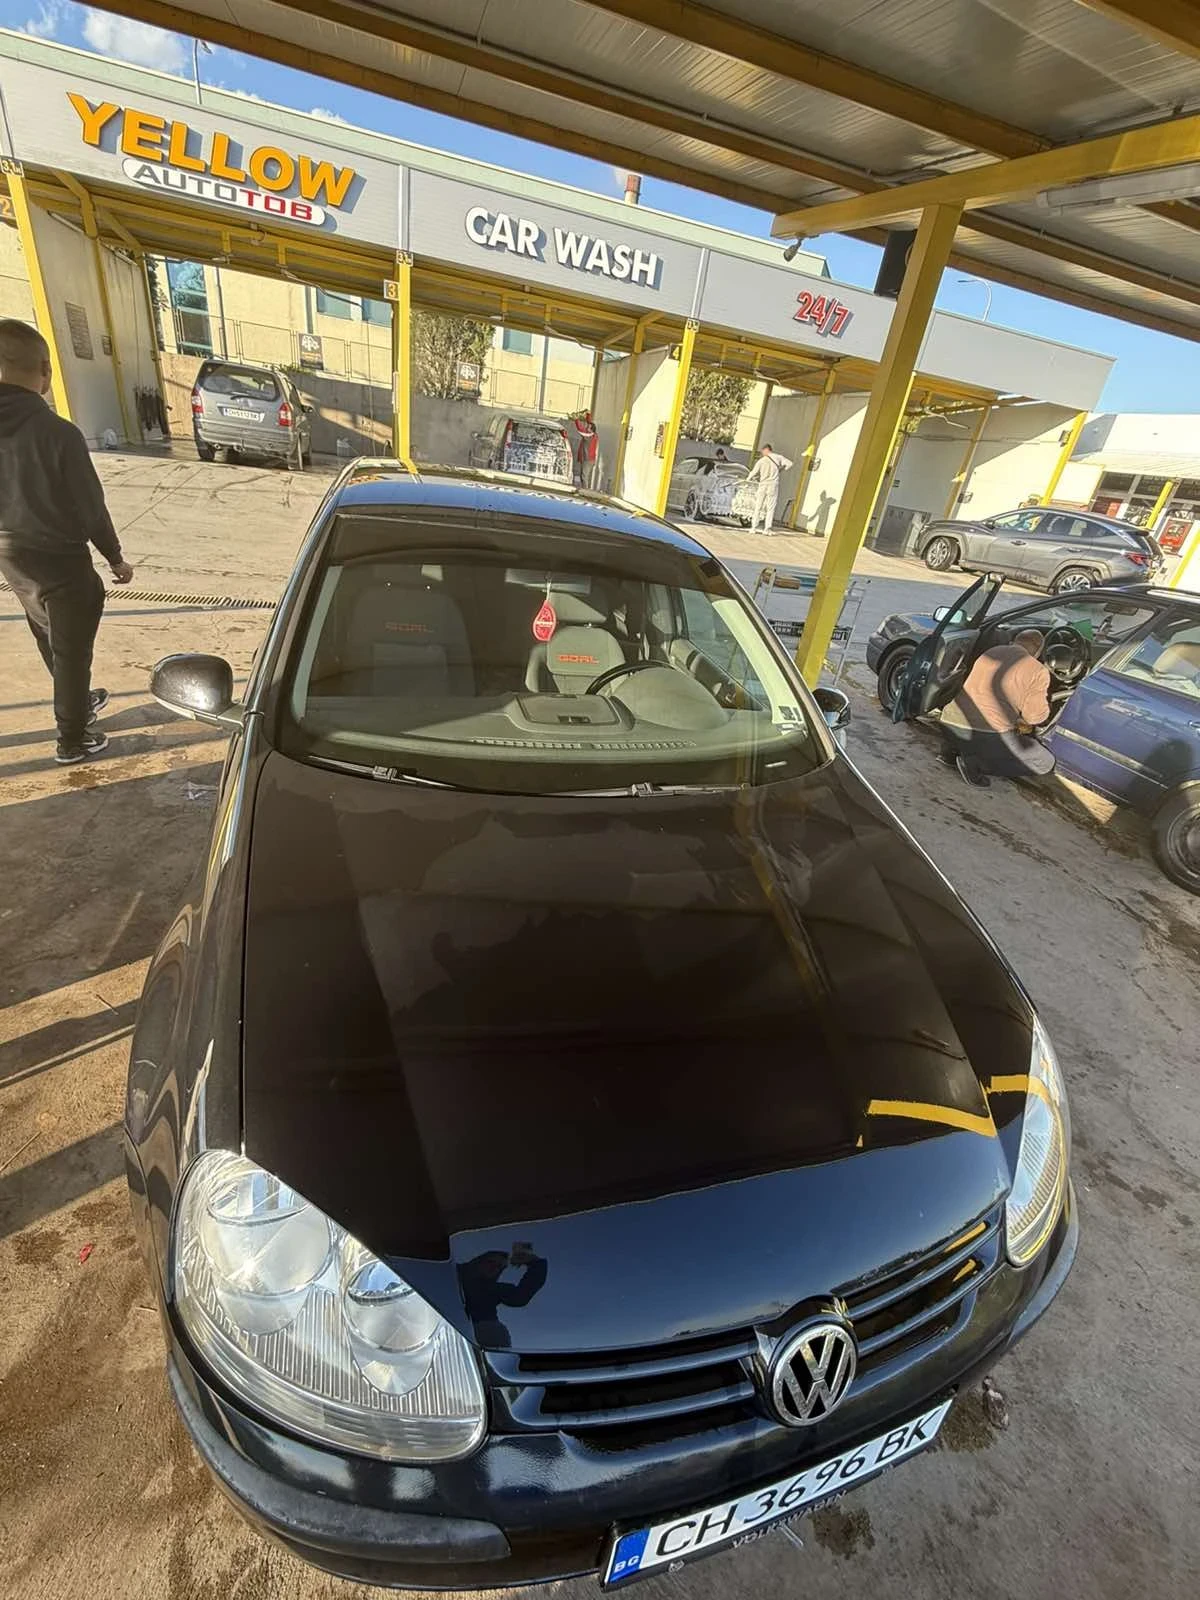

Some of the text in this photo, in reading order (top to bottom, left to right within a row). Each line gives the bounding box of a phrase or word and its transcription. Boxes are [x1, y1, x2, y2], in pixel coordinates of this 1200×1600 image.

[66, 92, 356, 207] YELLOW
[133, 163, 314, 222] AUTOTOB
[465, 206, 658, 286] CAR WASH
[388, 283, 397, 298] 3
[793, 289, 850, 335] 24/7
[773, 1324, 857, 1428] VW
[655, 1409, 942, 1557] CH 3696 BK
[614, 1555, 640, 1573] BG
